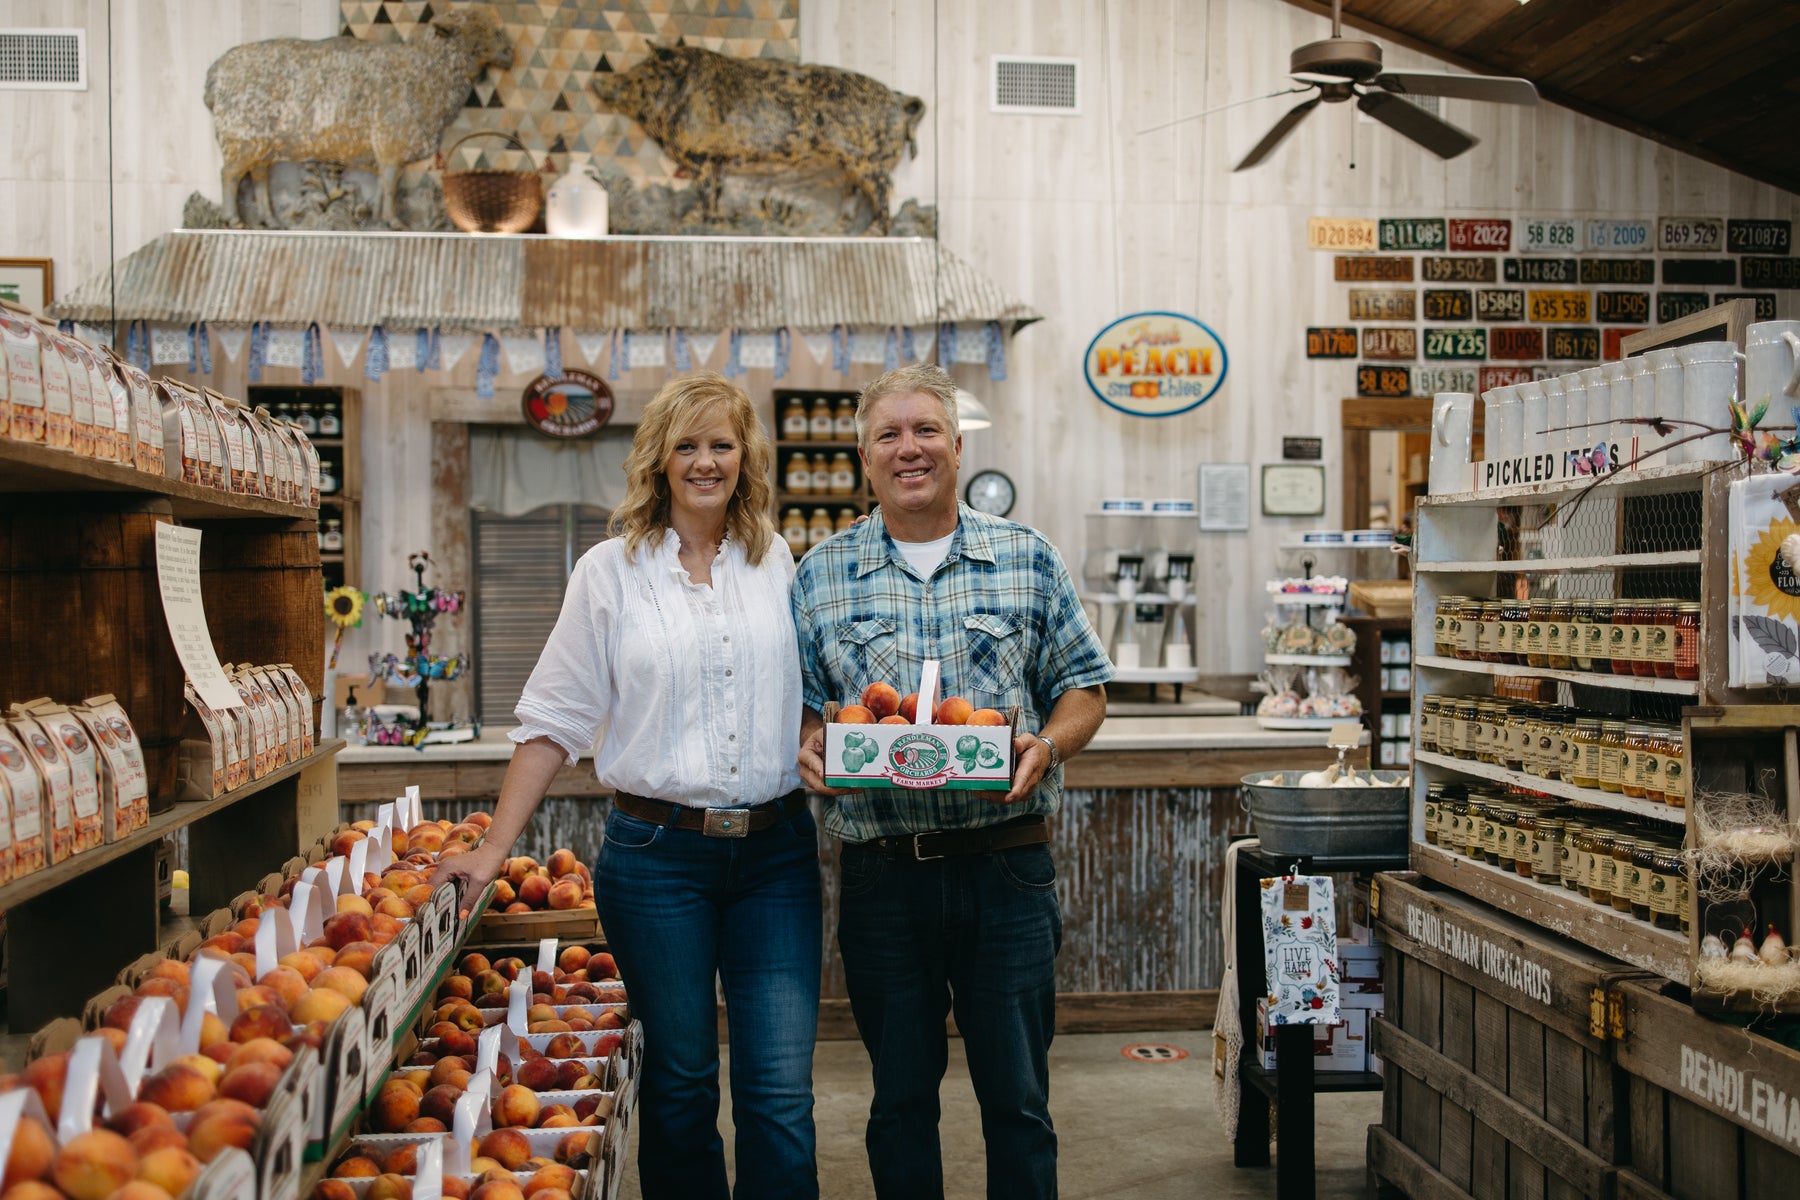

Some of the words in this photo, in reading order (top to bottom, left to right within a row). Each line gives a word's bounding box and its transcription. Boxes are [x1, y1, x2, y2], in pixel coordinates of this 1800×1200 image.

[1473, 225, 1508, 246] 2022
[1528, 225, 1544, 244] 58
[1549, 225, 1574, 245] 828
[1613, 226, 1646, 245] 2009
[1665, 224, 1690, 243] B69
[1427, 334, 1453, 355] 274
[1457, 333, 1485, 355] 235
[1096, 347, 1214, 377] PEACH
[1486, 453, 1554, 487] PICKLED
[900, 766, 938, 777] ORCHARDS
[896, 778, 914, 786] FARM
[1284, 947, 1311, 961] LIVE
[1407, 904, 1479, 970] RENDLEMAN
[1482, 940, 1551, 1005] ORCHARDS
[1284, 961, 1311, 973] HAPPY
